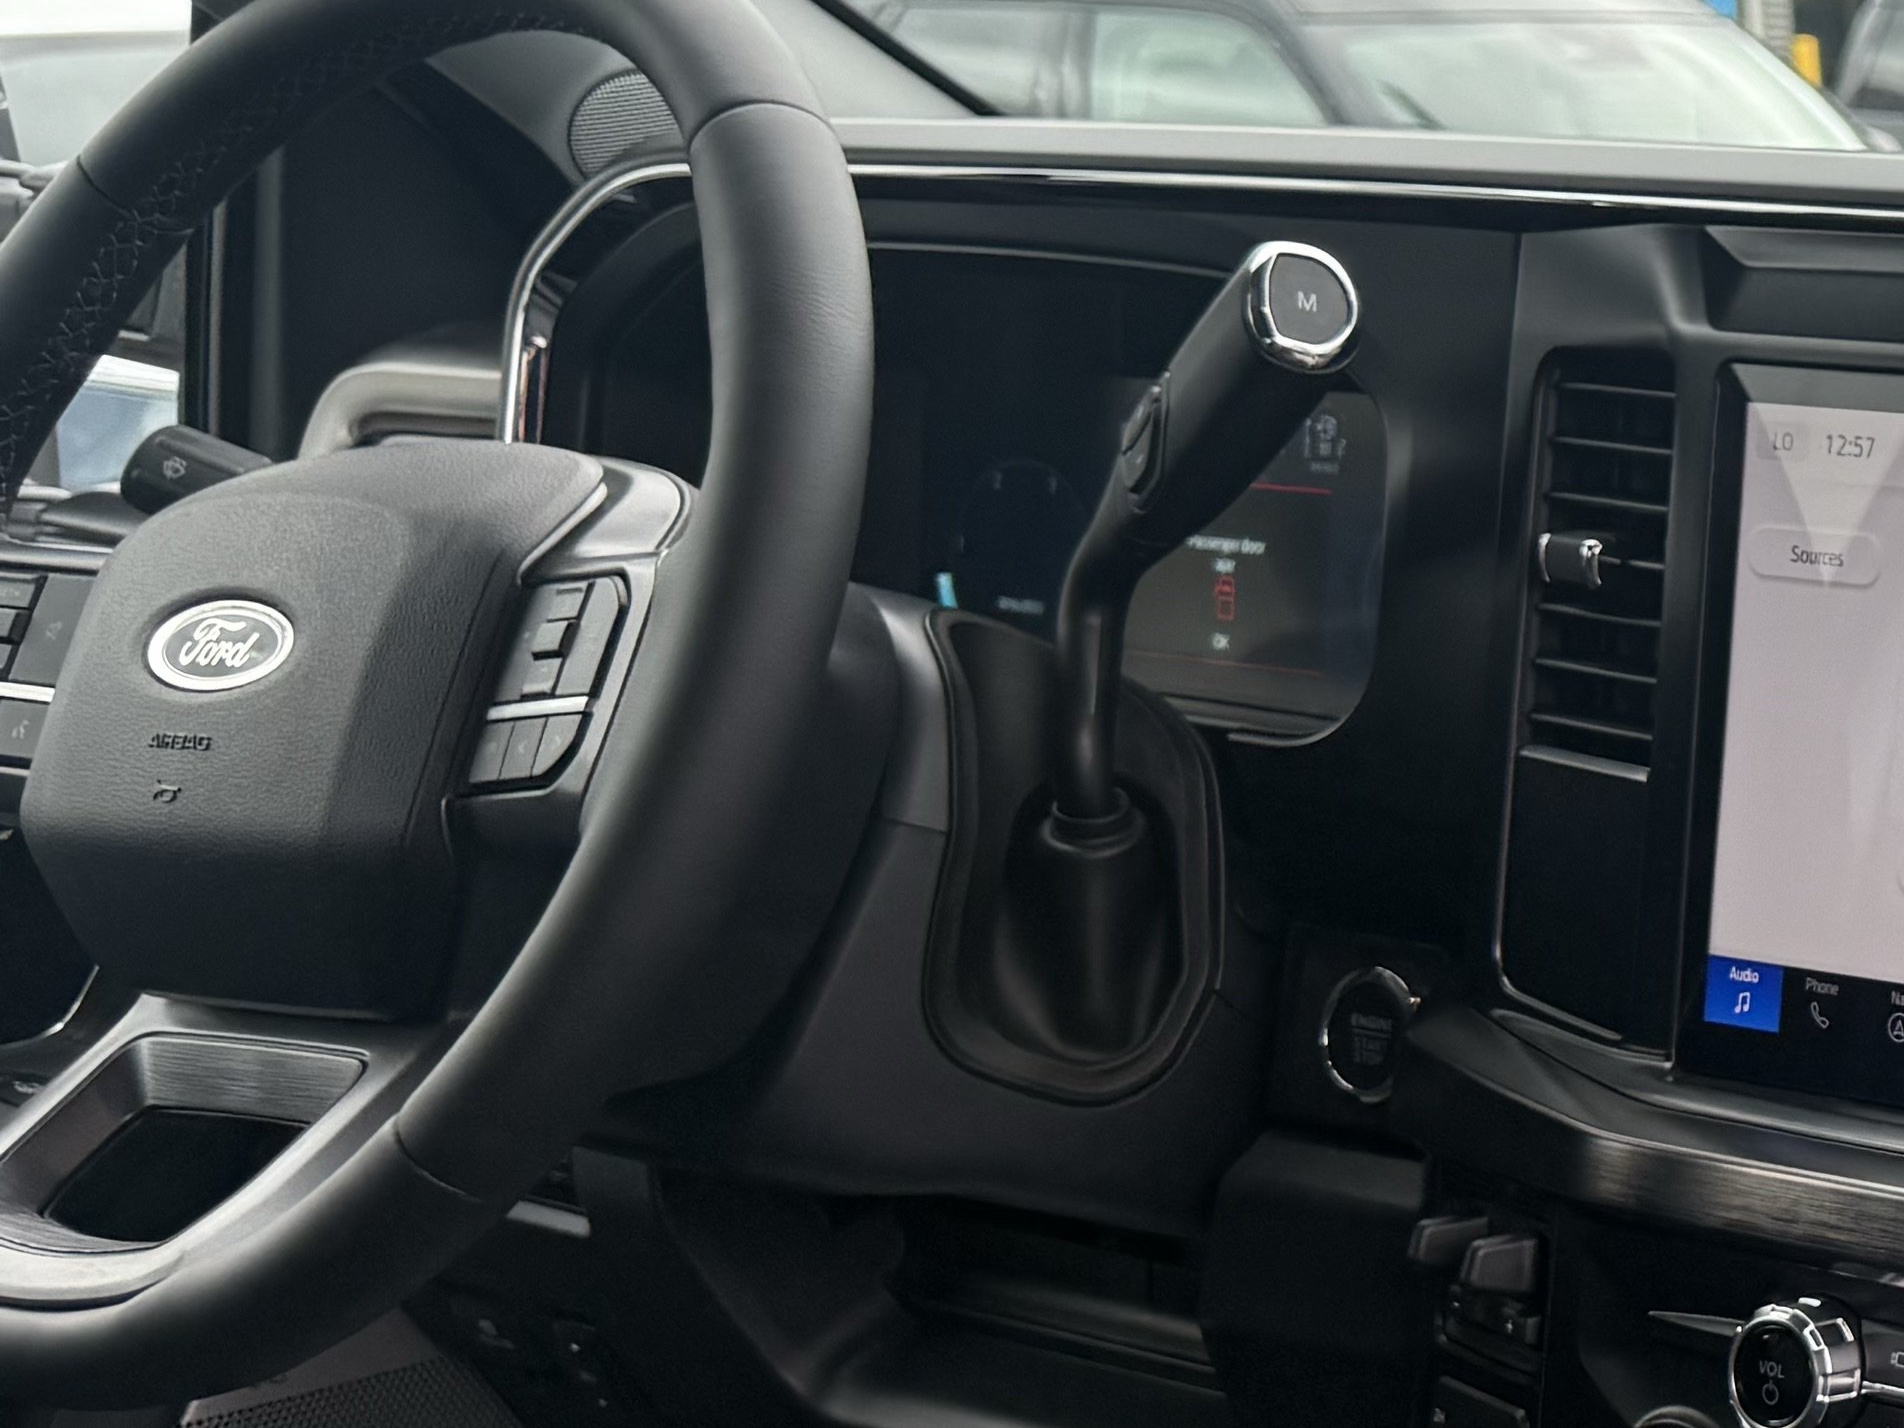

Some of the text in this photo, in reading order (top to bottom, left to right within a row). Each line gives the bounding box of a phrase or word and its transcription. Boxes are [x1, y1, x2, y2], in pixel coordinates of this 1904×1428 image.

[1297, 289, 1318, 313] M
[1825, 433, 1876, 460] 12:57
[1789, 544, 1845, 568] Sources
[178, 617, 260, 668] Ford
[1728, 965, 1760, 984] Audio
[1804, 977, 1840, 998] Phone
[1758, 1359, 1786, 1380] VOL
